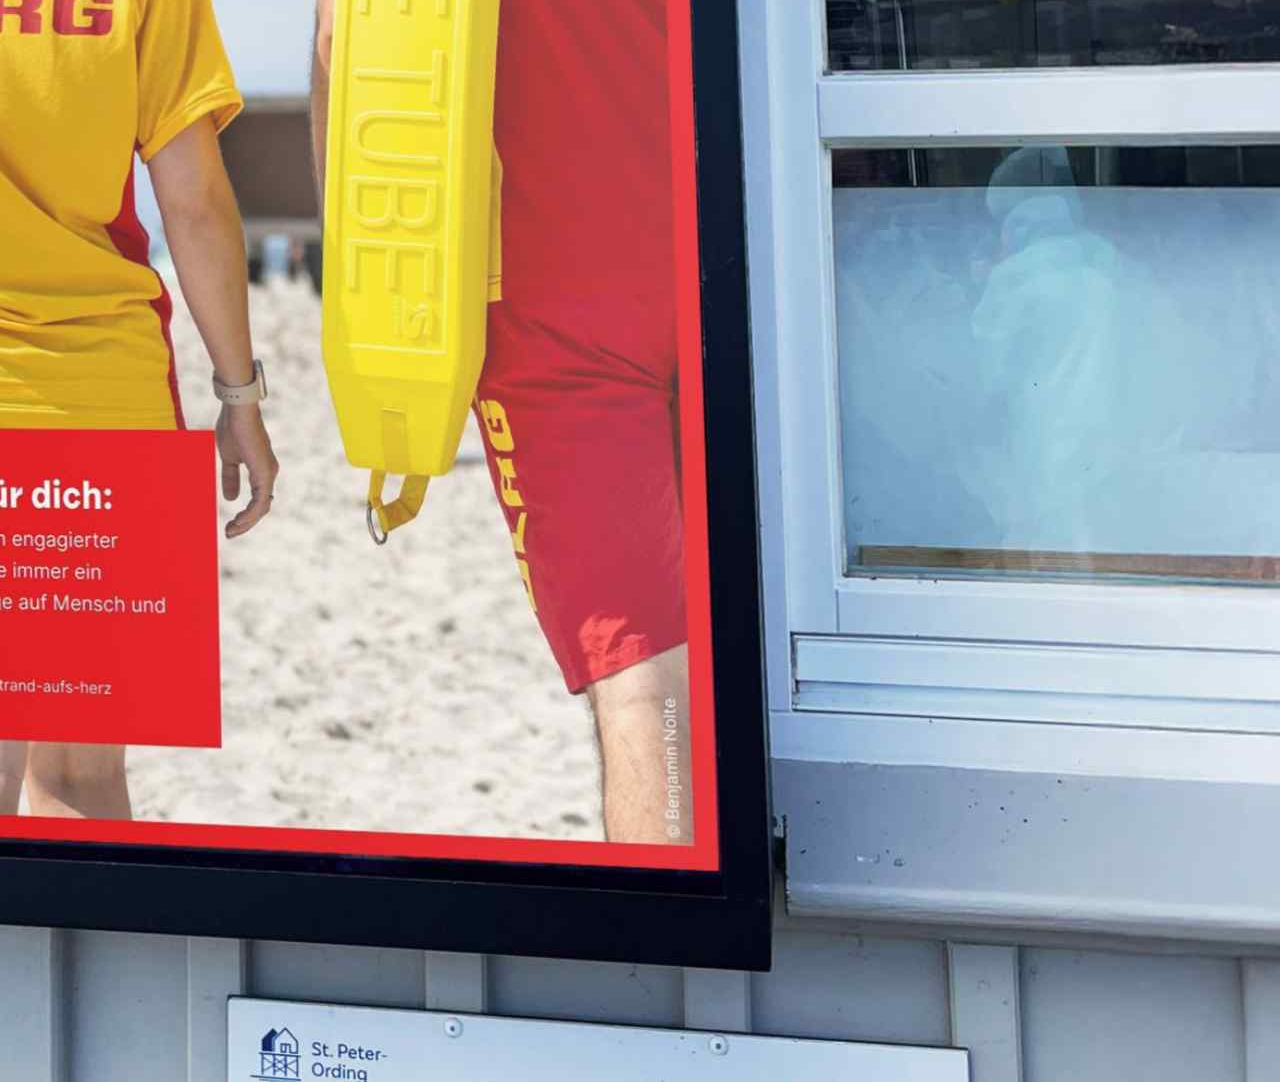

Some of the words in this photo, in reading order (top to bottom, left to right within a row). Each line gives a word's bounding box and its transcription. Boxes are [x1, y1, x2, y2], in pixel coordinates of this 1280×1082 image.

[347, 49, 445, 296] TUBE
[31, 479, 113, 510] dich:
[11, 530, 118, 552] engagierter
[12, 562, 69, 580] immer
[74, 563, 102, 581] ein
[18, 592, 48, 611] auf
[52, 594, 126, 613] Mensch
[131, 596, 166, 615] und
[663, 697, 677, 740] Nolte
[665, 746, 682, 820] Benjamin
[311, 1041, 334, 1058] St.
[337, 1043, 388, 1061] Peter-
[311, 1062, 368, 1082] Ording
